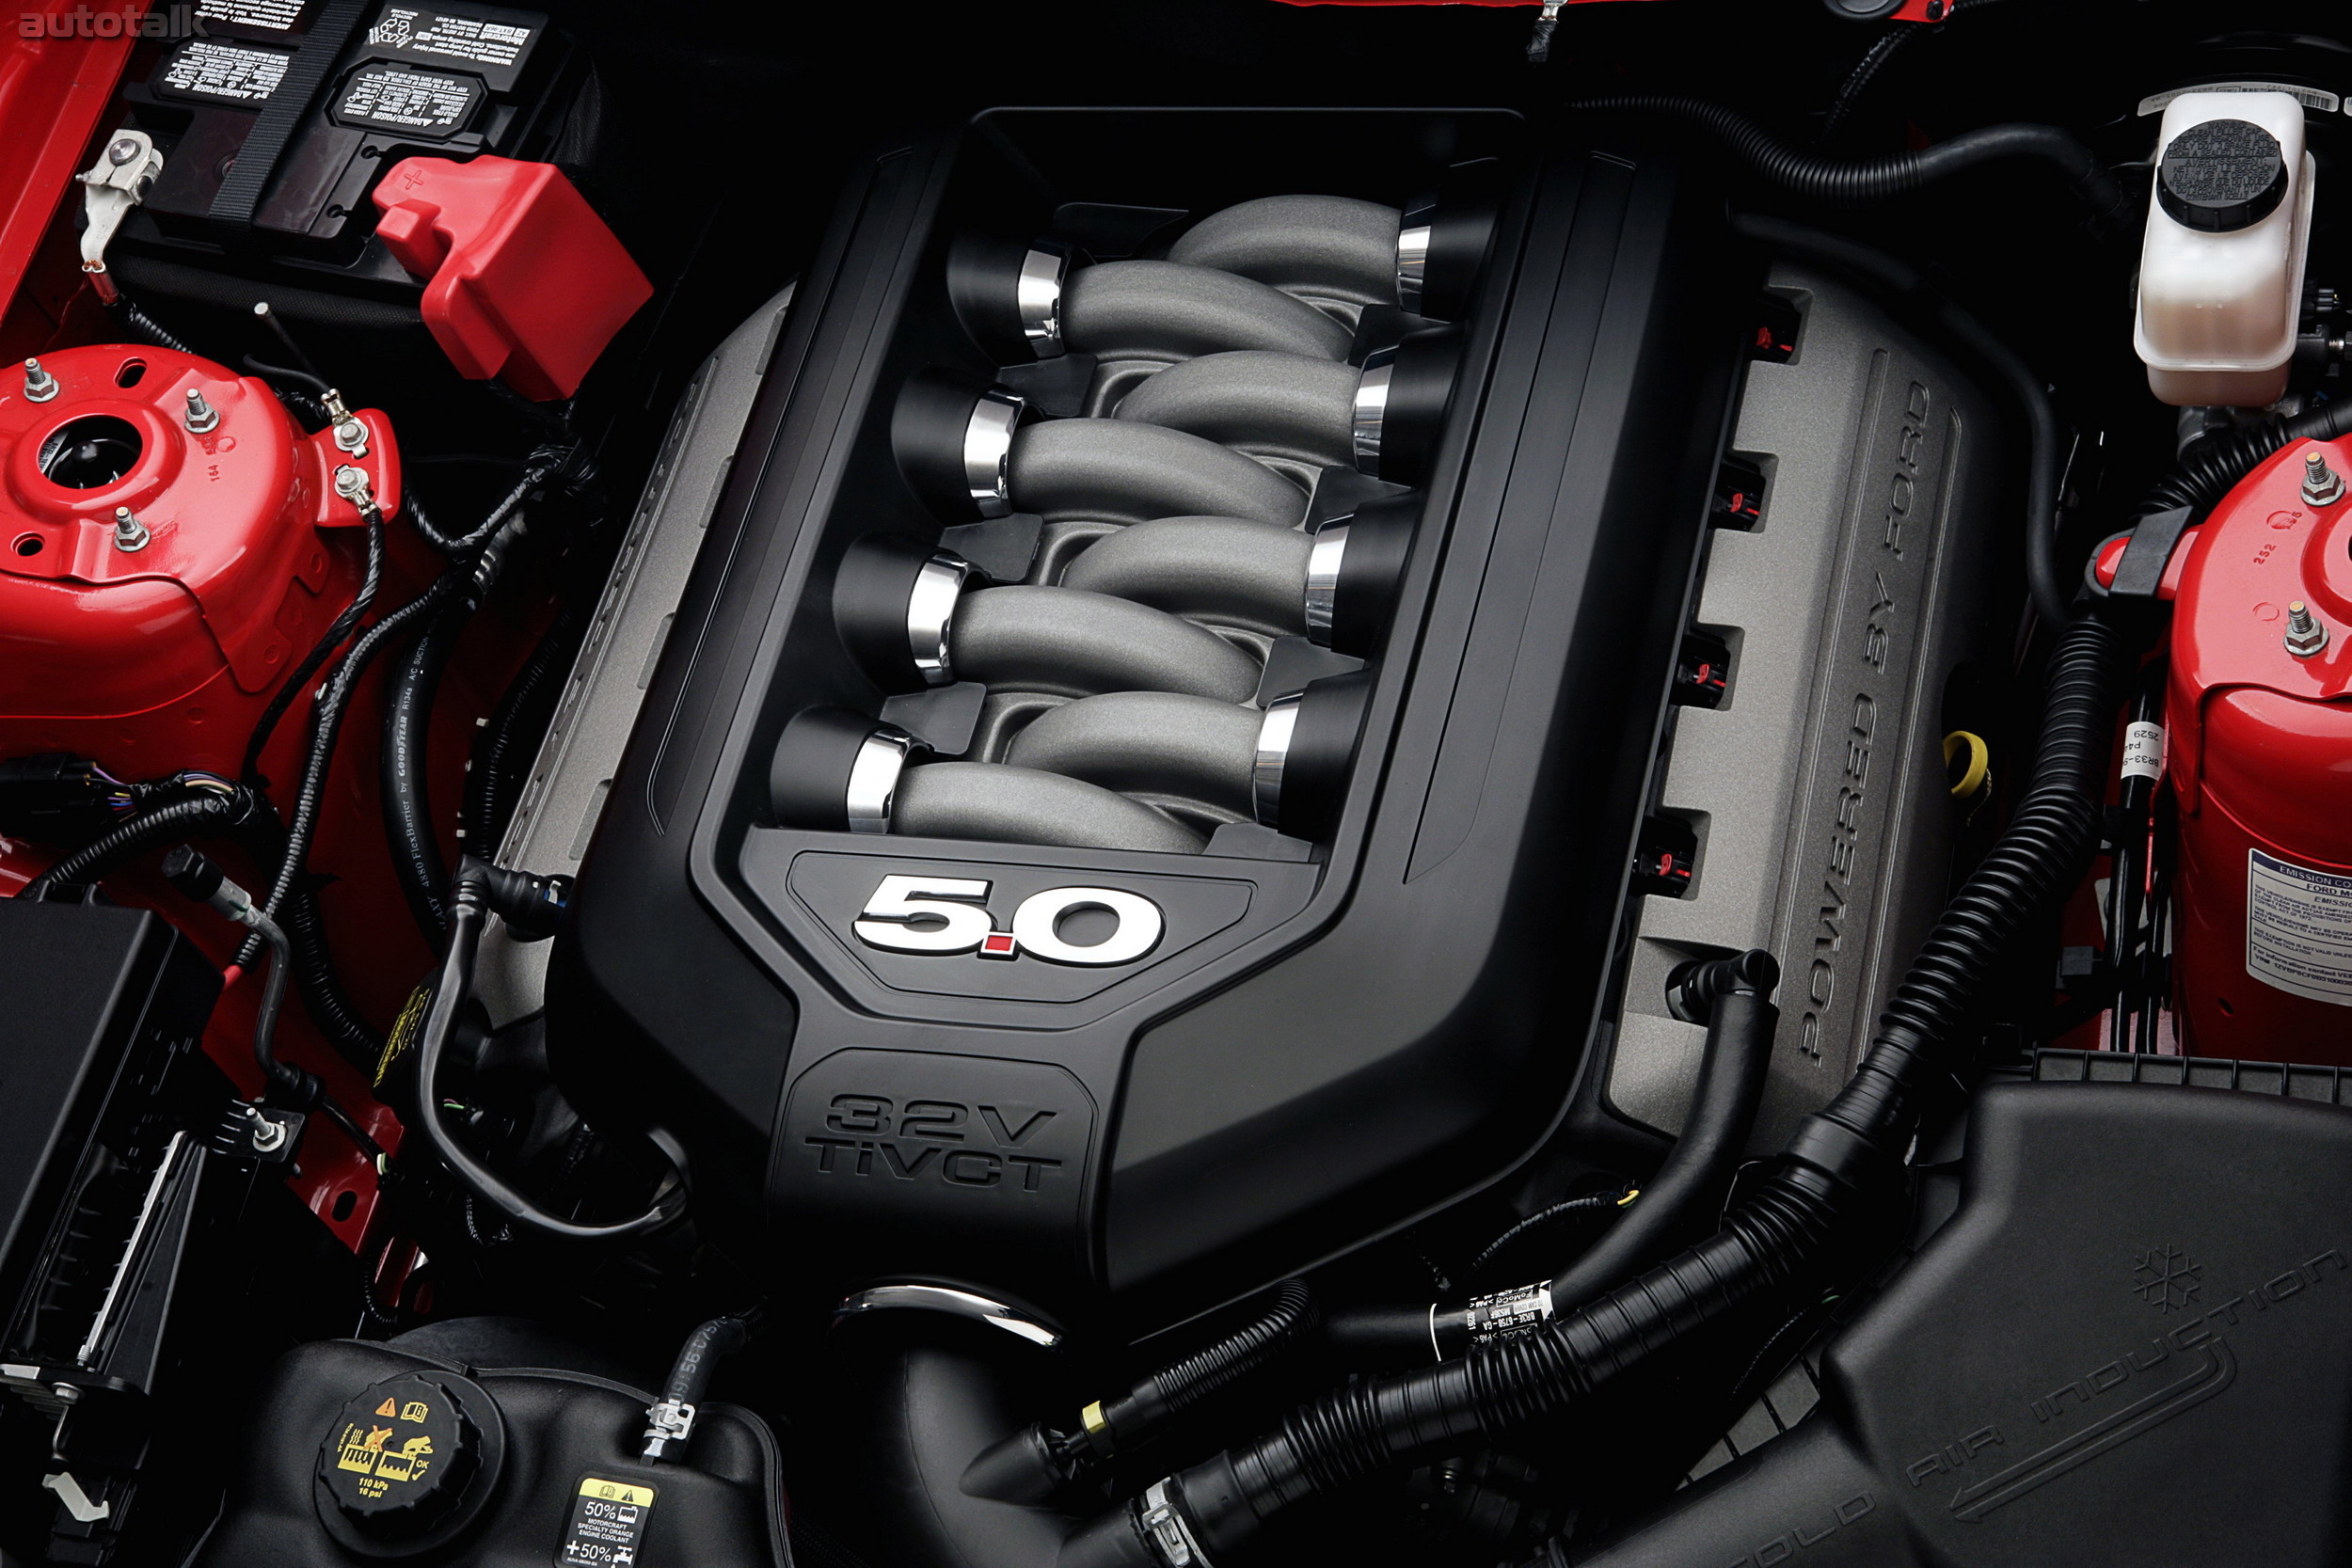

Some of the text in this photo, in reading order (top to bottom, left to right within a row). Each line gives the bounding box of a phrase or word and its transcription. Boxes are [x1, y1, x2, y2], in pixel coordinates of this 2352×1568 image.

[479, 31, 525, 45] Motorcraft
[372, 111, 423, 126] DANGER/POISON
[2253, 544, 2276, 564] 252
[413, 635, 430, 665] SUCTION
[408, 667, 419, 680] A/C
[402, 687, 414, 710] R134a
[1801, 380, 1931, 1067] POWERED BY FORD
[2134, 731, 2159, 741] 2529
[396, 714, 409, 776] GOODYEAR
[398, 781, 409, 793] by
[397, 799, 423, 860] FlexBarrier
[414, 861, 430, 888] 4880
[2280, 865, 2331, 885] EMISSION
[2306, 883, 2337, 895] FORD
[853, 874, 1166, 967] 5.0
[2308, 966, 2336, 976] contact
[826, 1093, 1058, 1148] 32V
[1497, 1292, 1530, 1303] FoMoCo
[1906, 1425, 2005, 1487] AIR
[2030, 1248, 2347, 1422] INDUCTION
[415, 1459, 429, 1469] OK
[358, 1477, 389, 1491] 110 kPa
[358, 1486, 382, 1499] 16 psi
[584, 1500, 617, 1519] 50%
[577, 1522, 633, 1538] SPECIALTY ORANGE
[587, 1518, 627, 1529] MOTORCRAFT
[579, 1529, 629, 1543] ENGINE COOLANT
